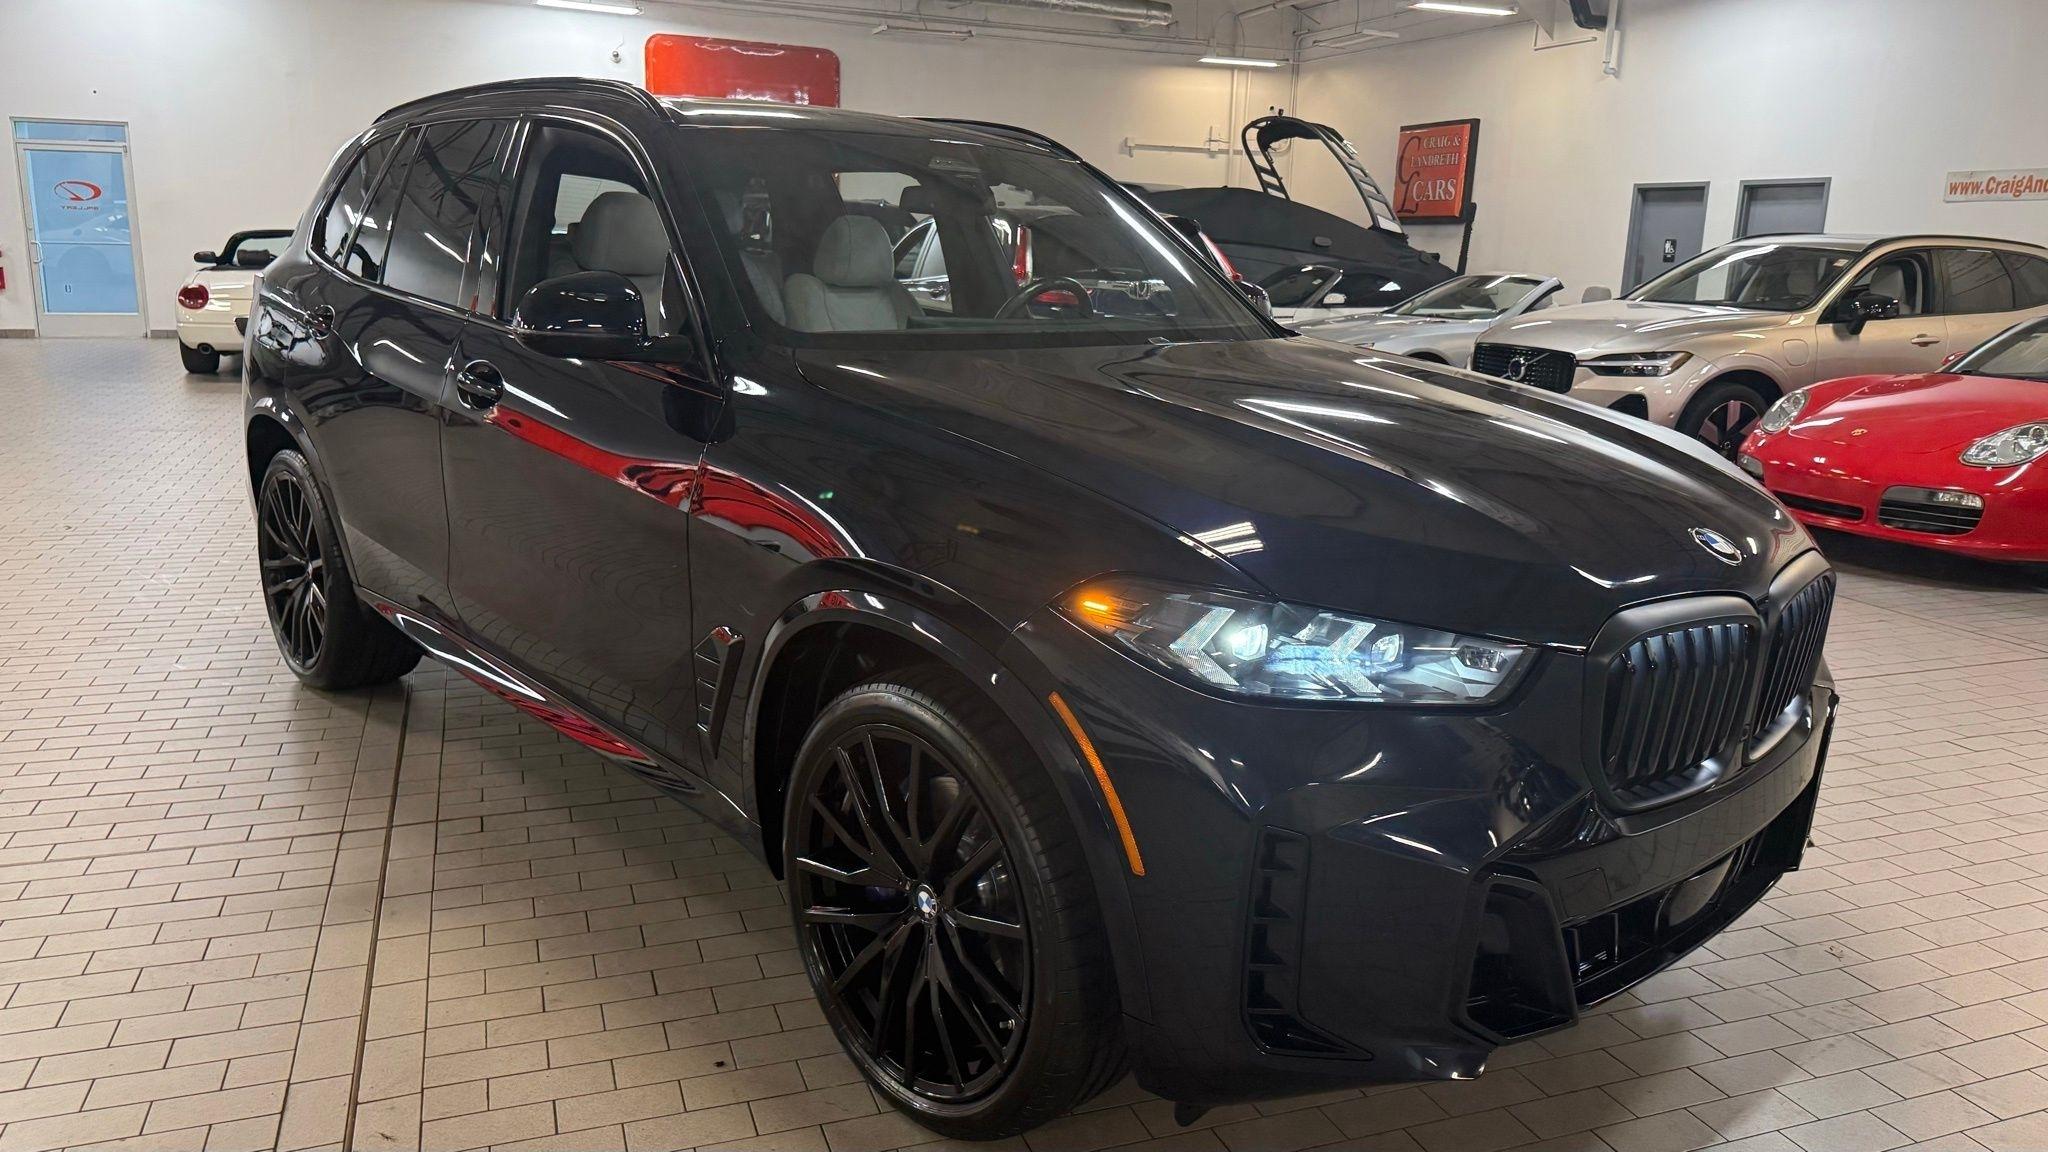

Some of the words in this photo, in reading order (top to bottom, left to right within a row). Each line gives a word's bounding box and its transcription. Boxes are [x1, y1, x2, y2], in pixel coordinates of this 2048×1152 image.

[1423, 135, 1450, 148] CRAIG
[1453, 134, 1461, 146] &
[1413, 179, 1456, 201] CARS
